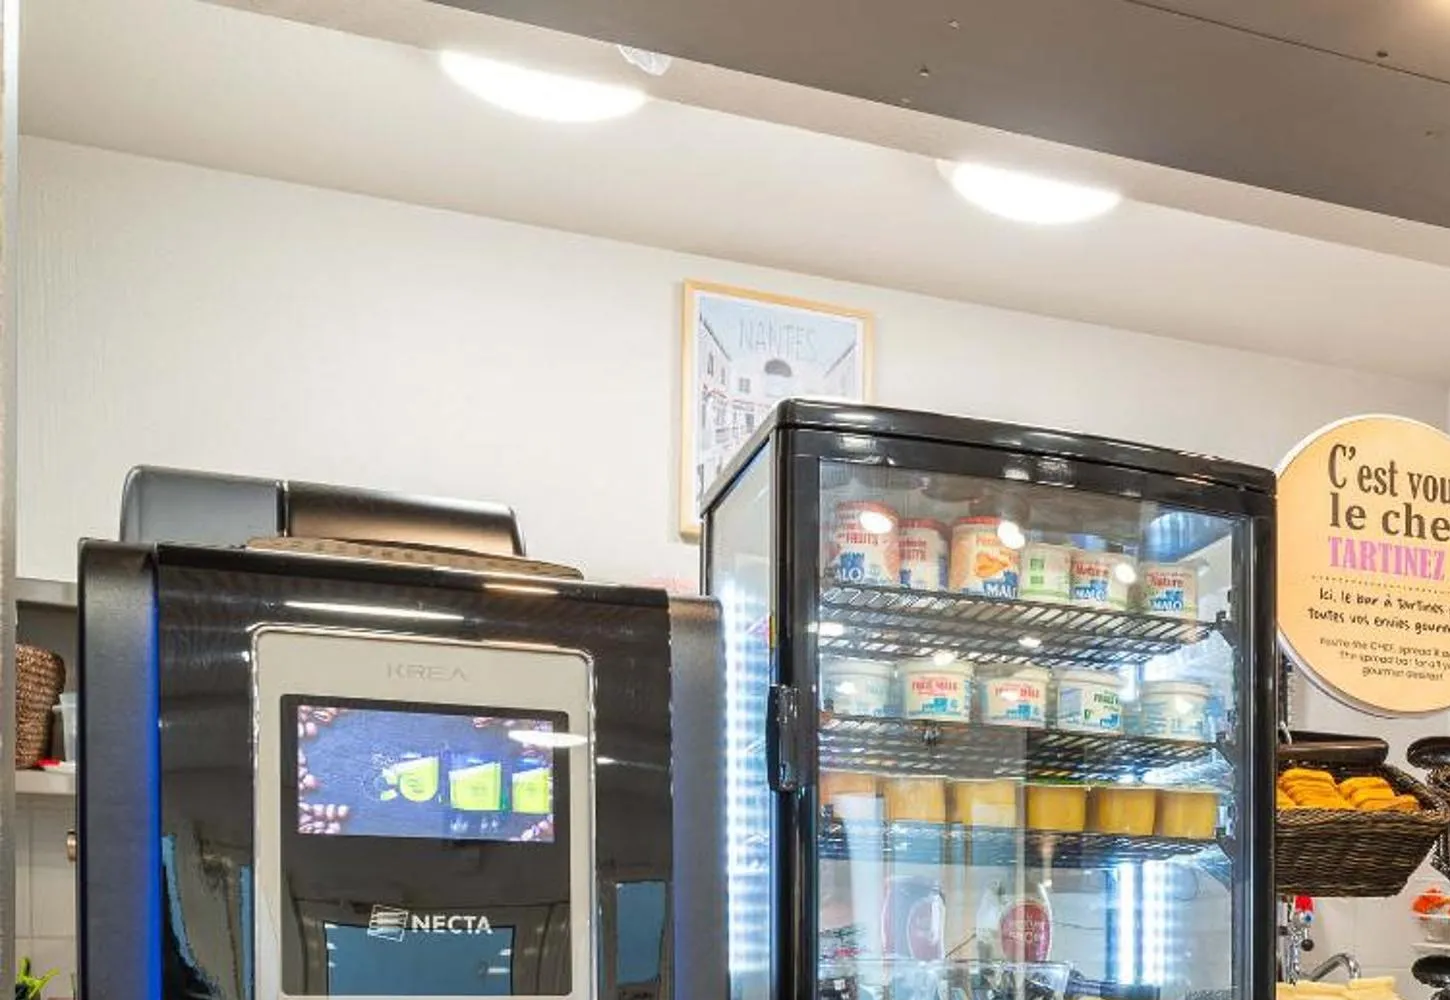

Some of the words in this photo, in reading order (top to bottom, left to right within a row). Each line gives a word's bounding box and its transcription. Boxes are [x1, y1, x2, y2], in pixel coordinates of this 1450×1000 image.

[1328, 443, 1398, 498] C'est
[1329, 492, 1367, 530] le
[1328, 536, 1446, 582] TARTINEZ
[1341, 590, 1351, 604] le
[1356, 592, 1379, 606] bar
[1349, 613, 1370, 626] vos
[1374, 616, 1411, 631] envies
[387, 663, 469, 683] KREA
[411, 915, 494, 936] NECTA
